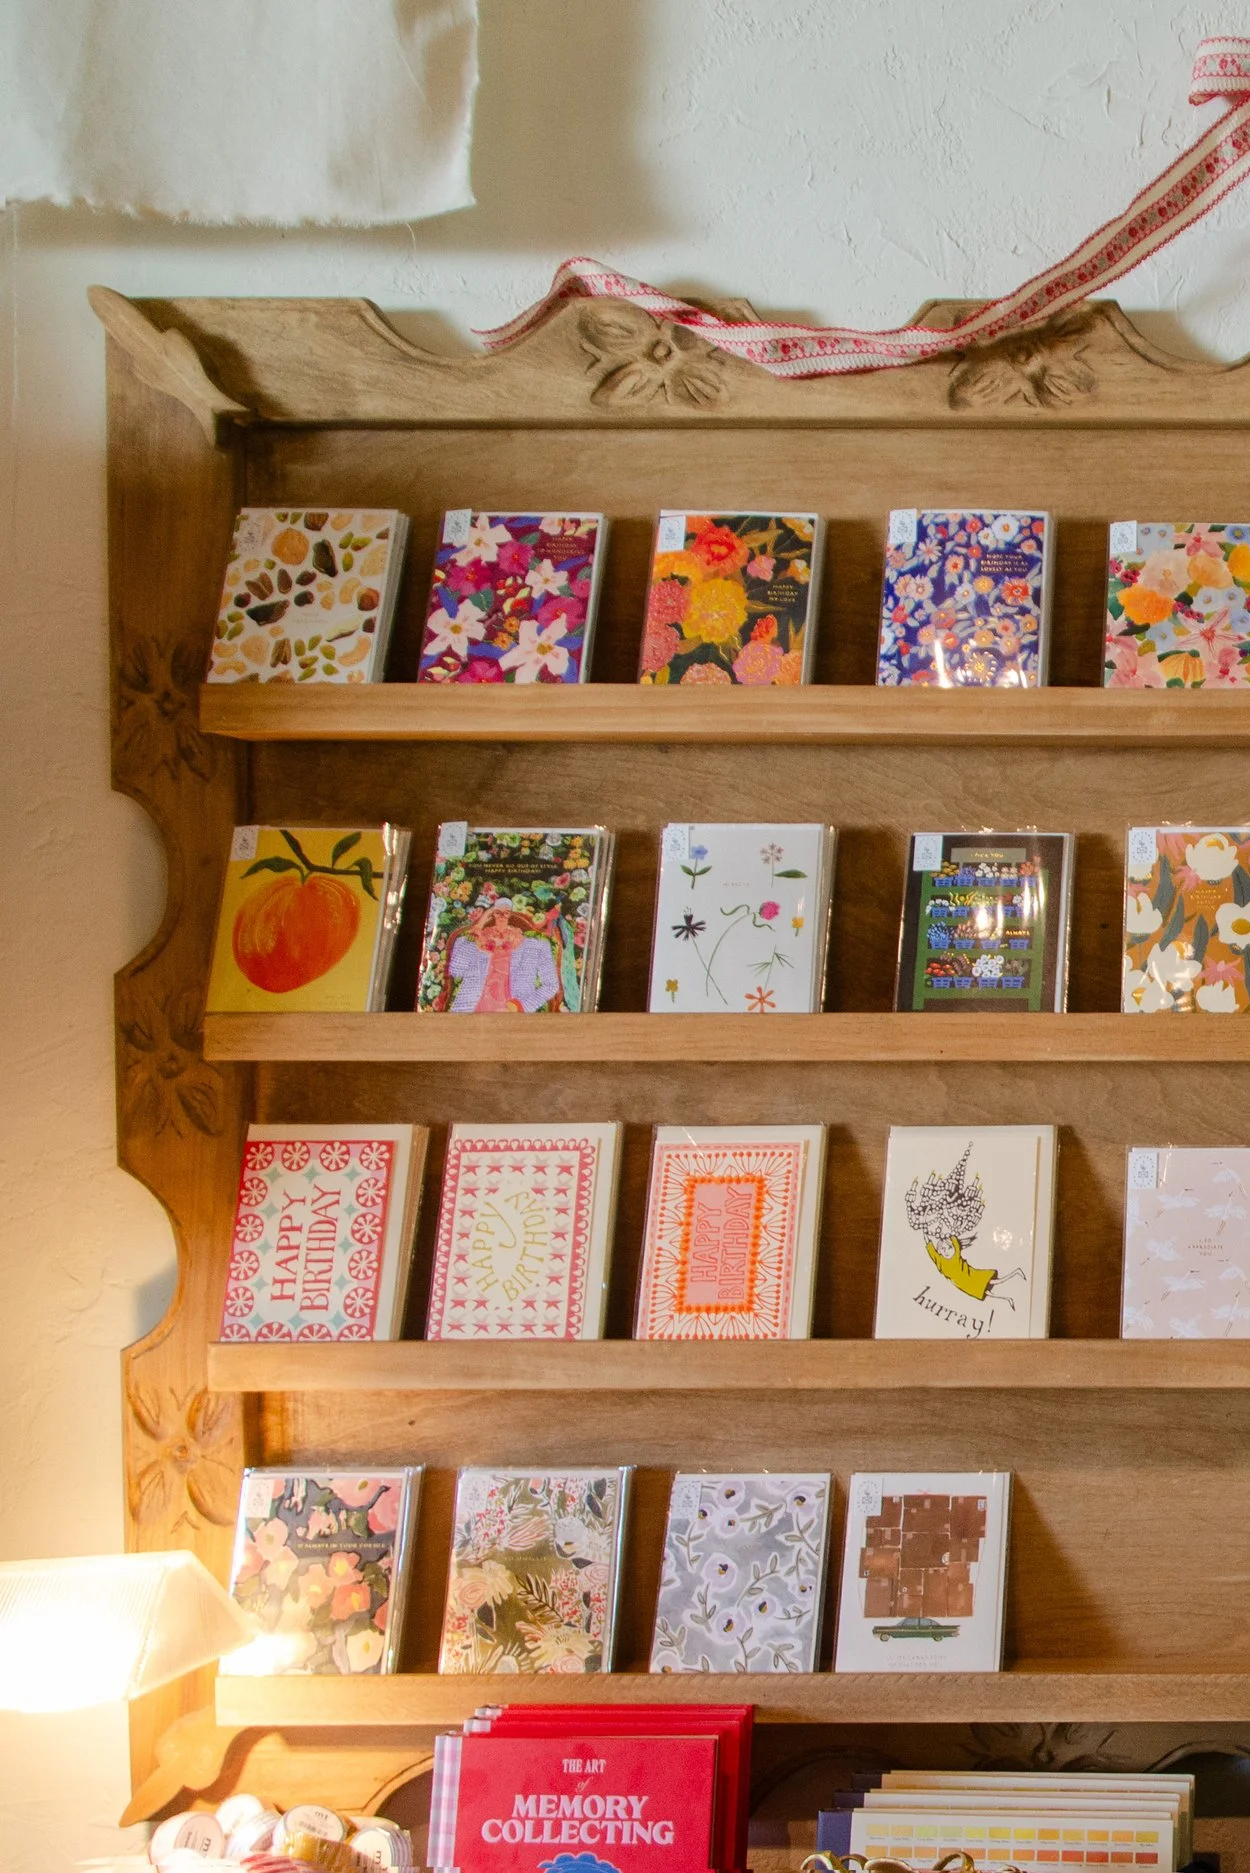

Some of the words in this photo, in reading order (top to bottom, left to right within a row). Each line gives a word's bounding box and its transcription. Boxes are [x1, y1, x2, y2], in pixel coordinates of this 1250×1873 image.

[271, 1189, 307, 1302] HAPPY
[299, 1184, 342, 1313] BIRTHDAY
[471, 1201, 517, 1293] HAPPY
[503, 1190, 549, 1303] BIRTHDAY
[691, 1201, 722, 1284] HAPPY
[717, 1185, 754, 1300] BIRTHDAY
[912, 1286, 994, 1340] hurray!
[511, 1793, 650, 1820] MEMORY
[563, 1759, 582, 1775] THE
[584, 1759, 606, 1775] ART
[577, 1775, 592, 1792] of
[480, 1817, 676, 1844] COLLECTING
